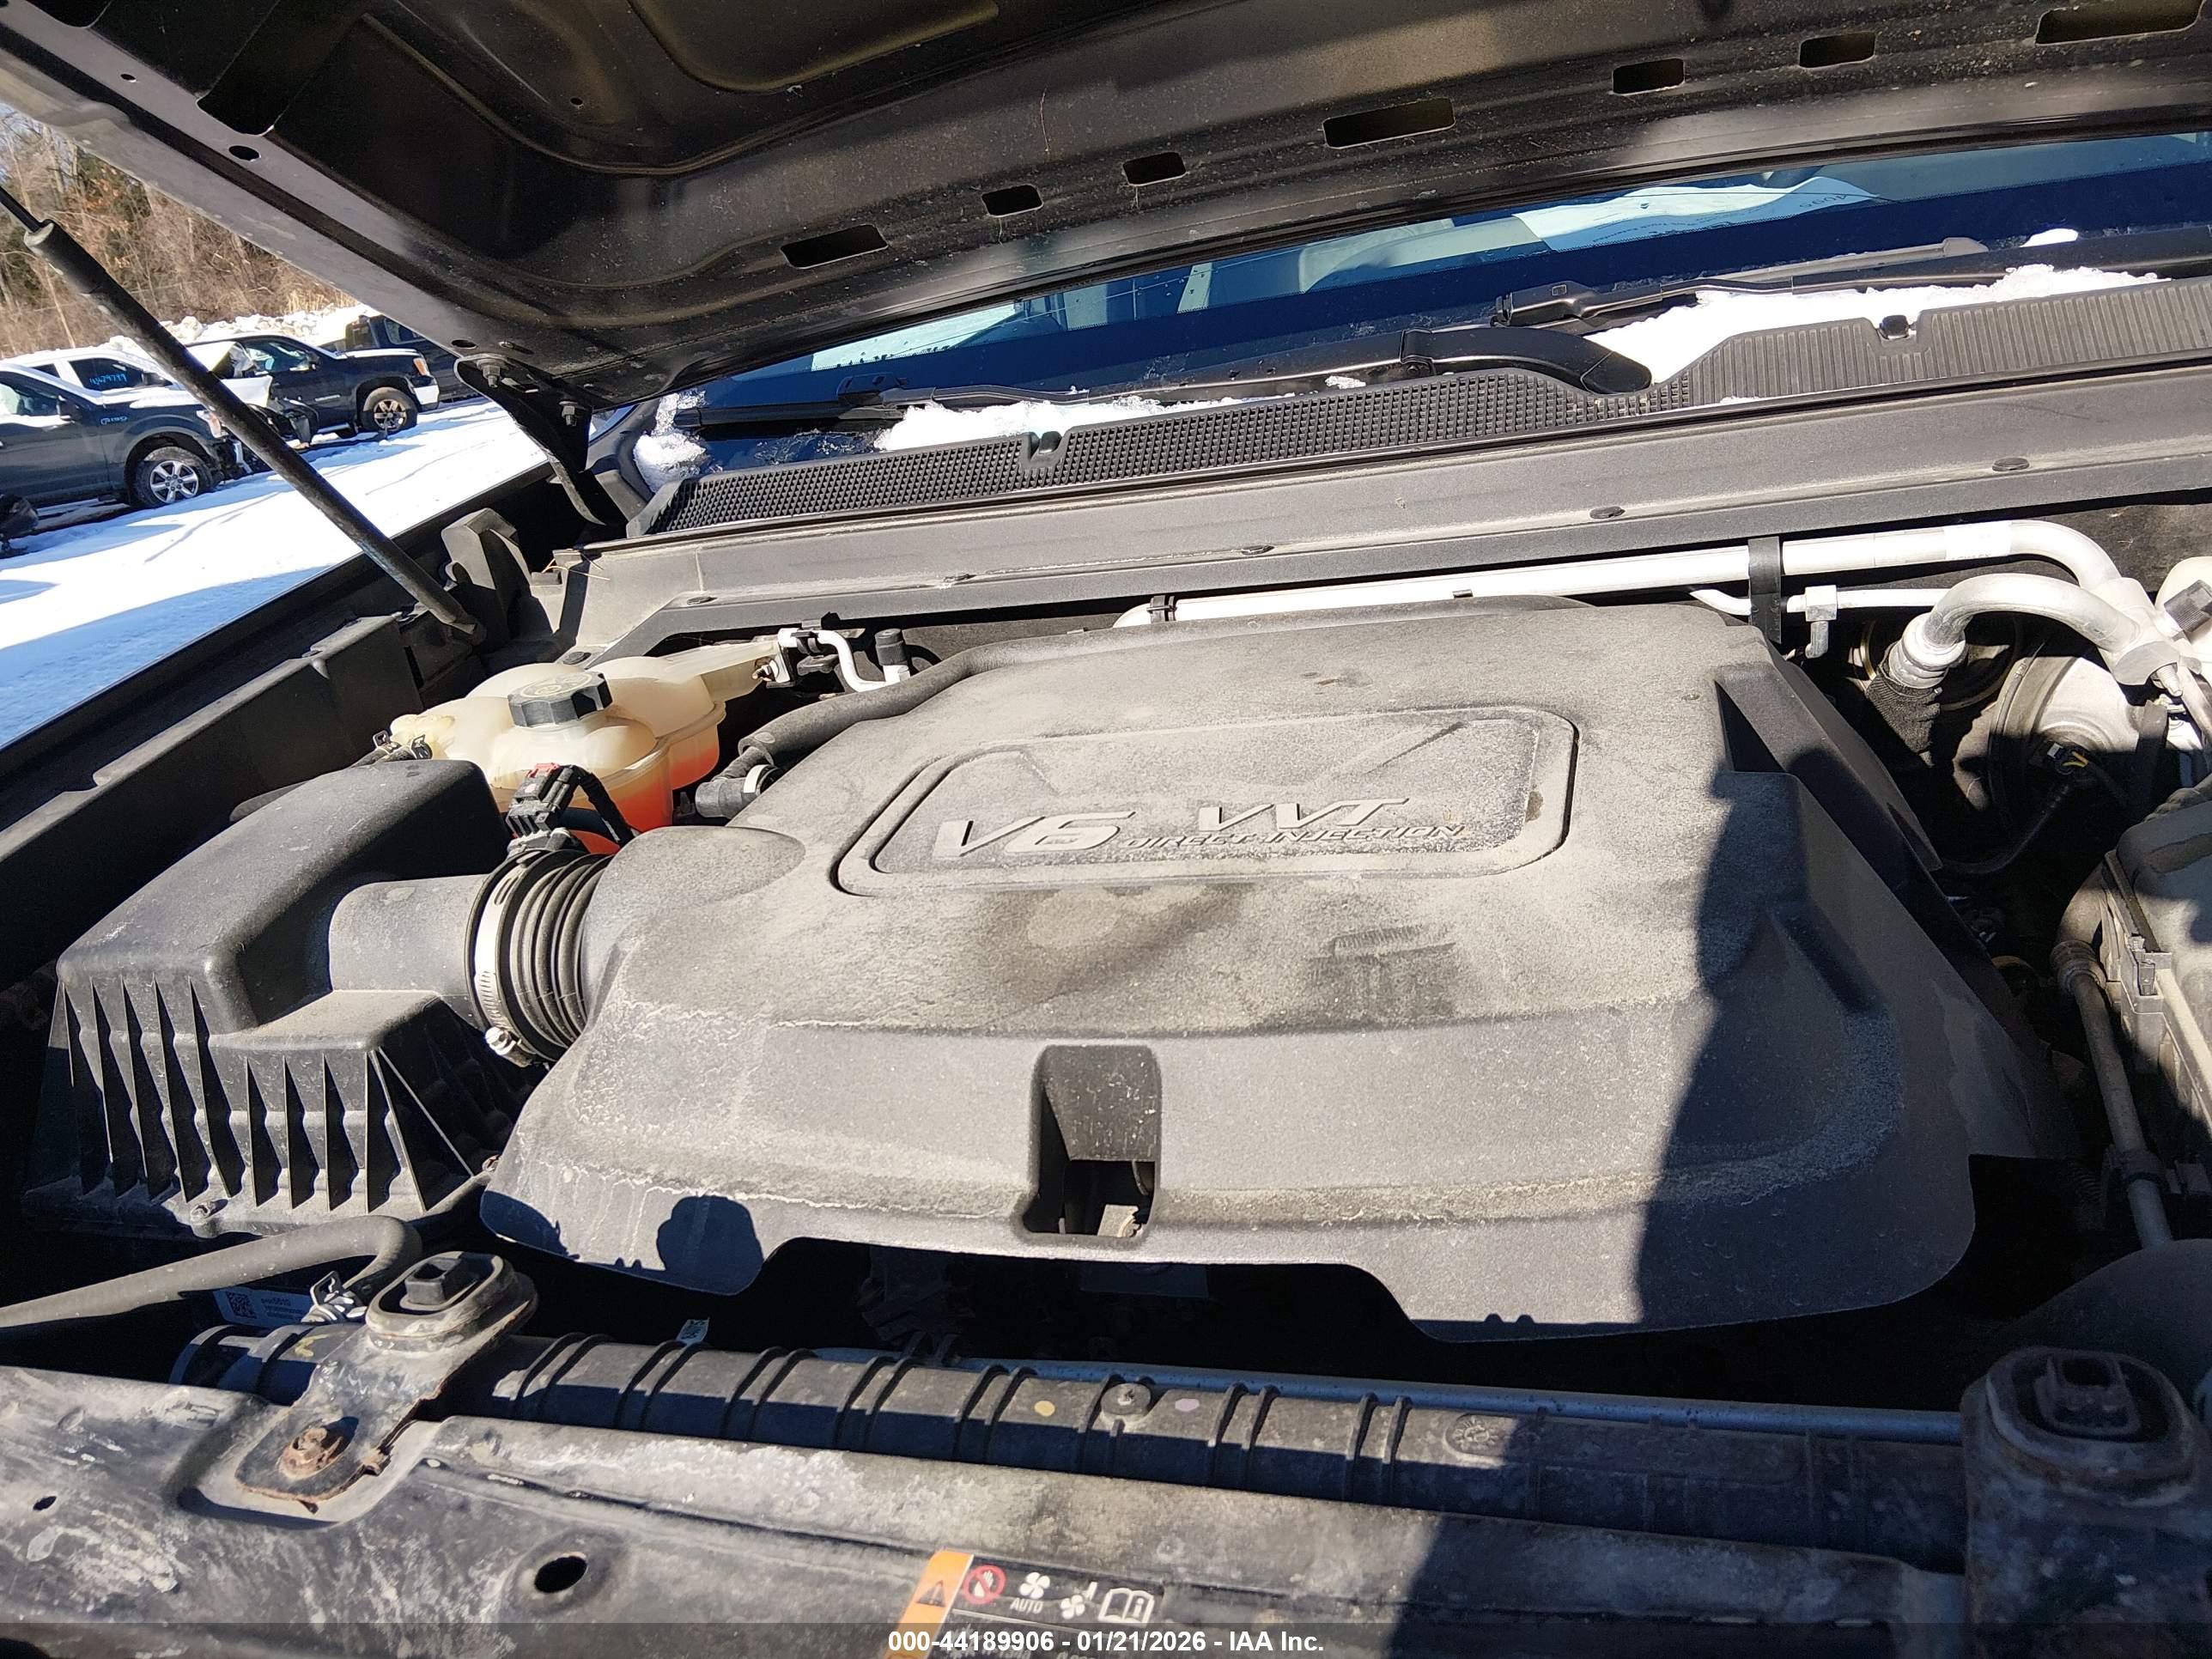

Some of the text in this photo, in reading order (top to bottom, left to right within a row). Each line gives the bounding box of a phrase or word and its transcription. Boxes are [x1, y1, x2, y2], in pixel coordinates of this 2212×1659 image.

[932, 797, 1411, 857] V6 VVT
[1118, 825, 1466, 849] DIRECT INJECTION
[1010, 1598, 1044, 1614] AUTO
